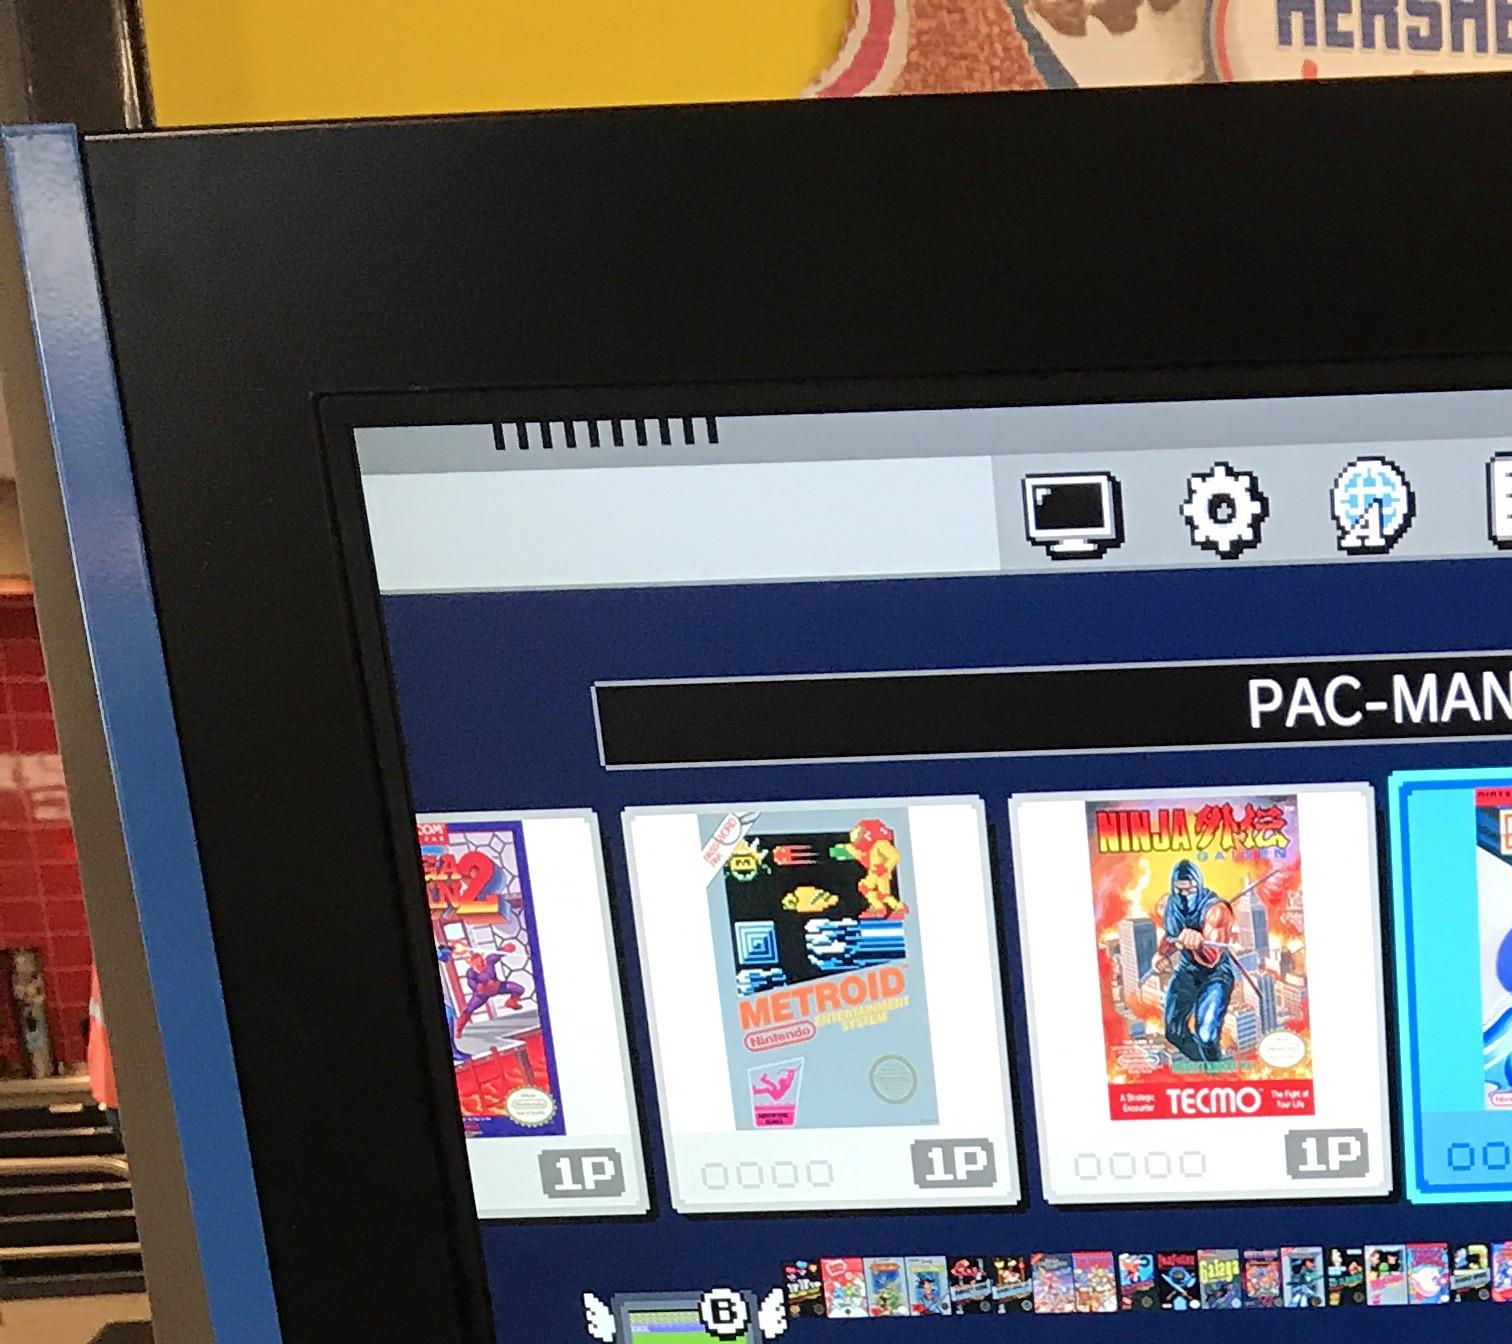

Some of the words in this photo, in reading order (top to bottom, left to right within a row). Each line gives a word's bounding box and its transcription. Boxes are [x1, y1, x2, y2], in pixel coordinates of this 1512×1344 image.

[1096, 809, 1192, 853] NINJA
[739, 966, 907, 1030] METROID
[749, 1027, 811, 1048] Nintendo
[1165, 1087, 1262, 1114] TECMO
[924, 1145, 991, 1182] 1P
[1300, 1135, 1362, 1172] 1P
[554, 1156, 616, 1191] 1P
[711, 1298, 739, 1324] B
